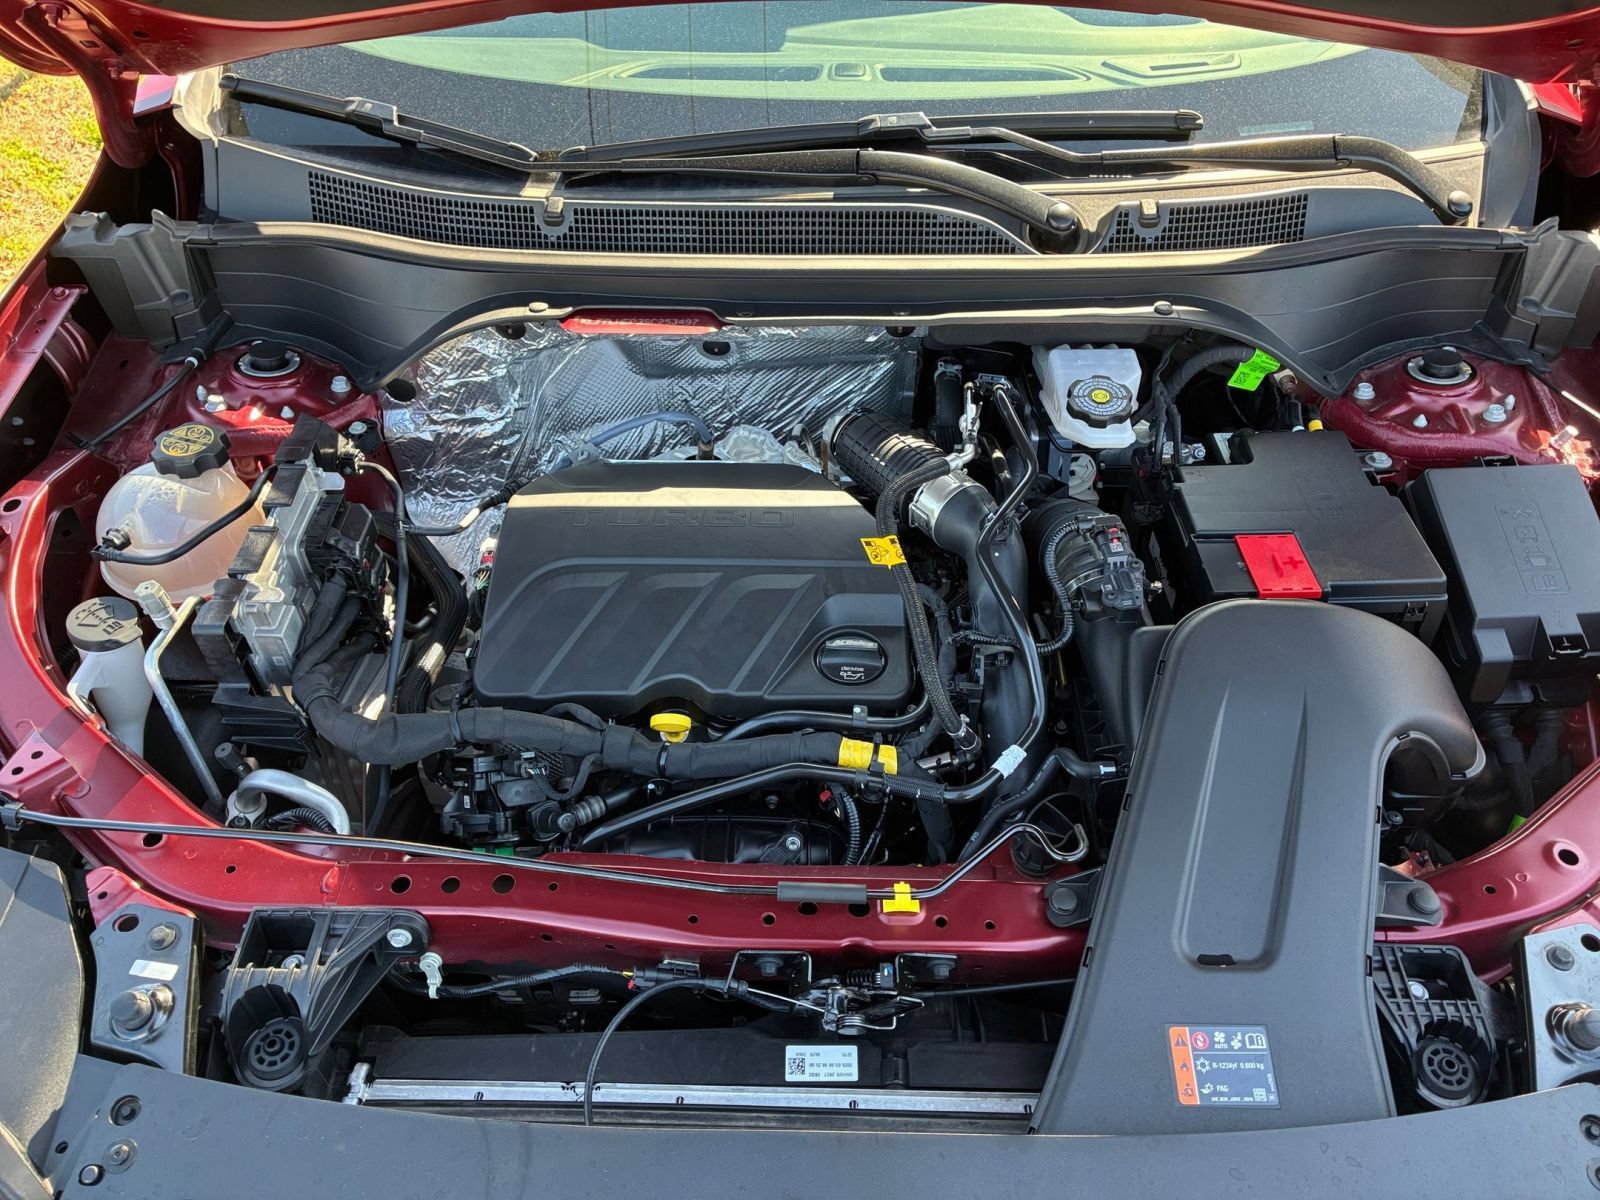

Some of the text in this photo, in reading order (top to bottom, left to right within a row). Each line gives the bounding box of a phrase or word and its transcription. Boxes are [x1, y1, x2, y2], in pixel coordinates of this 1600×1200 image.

[560, 509, 795, 528] TURBO
[1211, 1062, 1238, 1070] R-1234yf
[1256, 1062, 1265, 1071] kg
